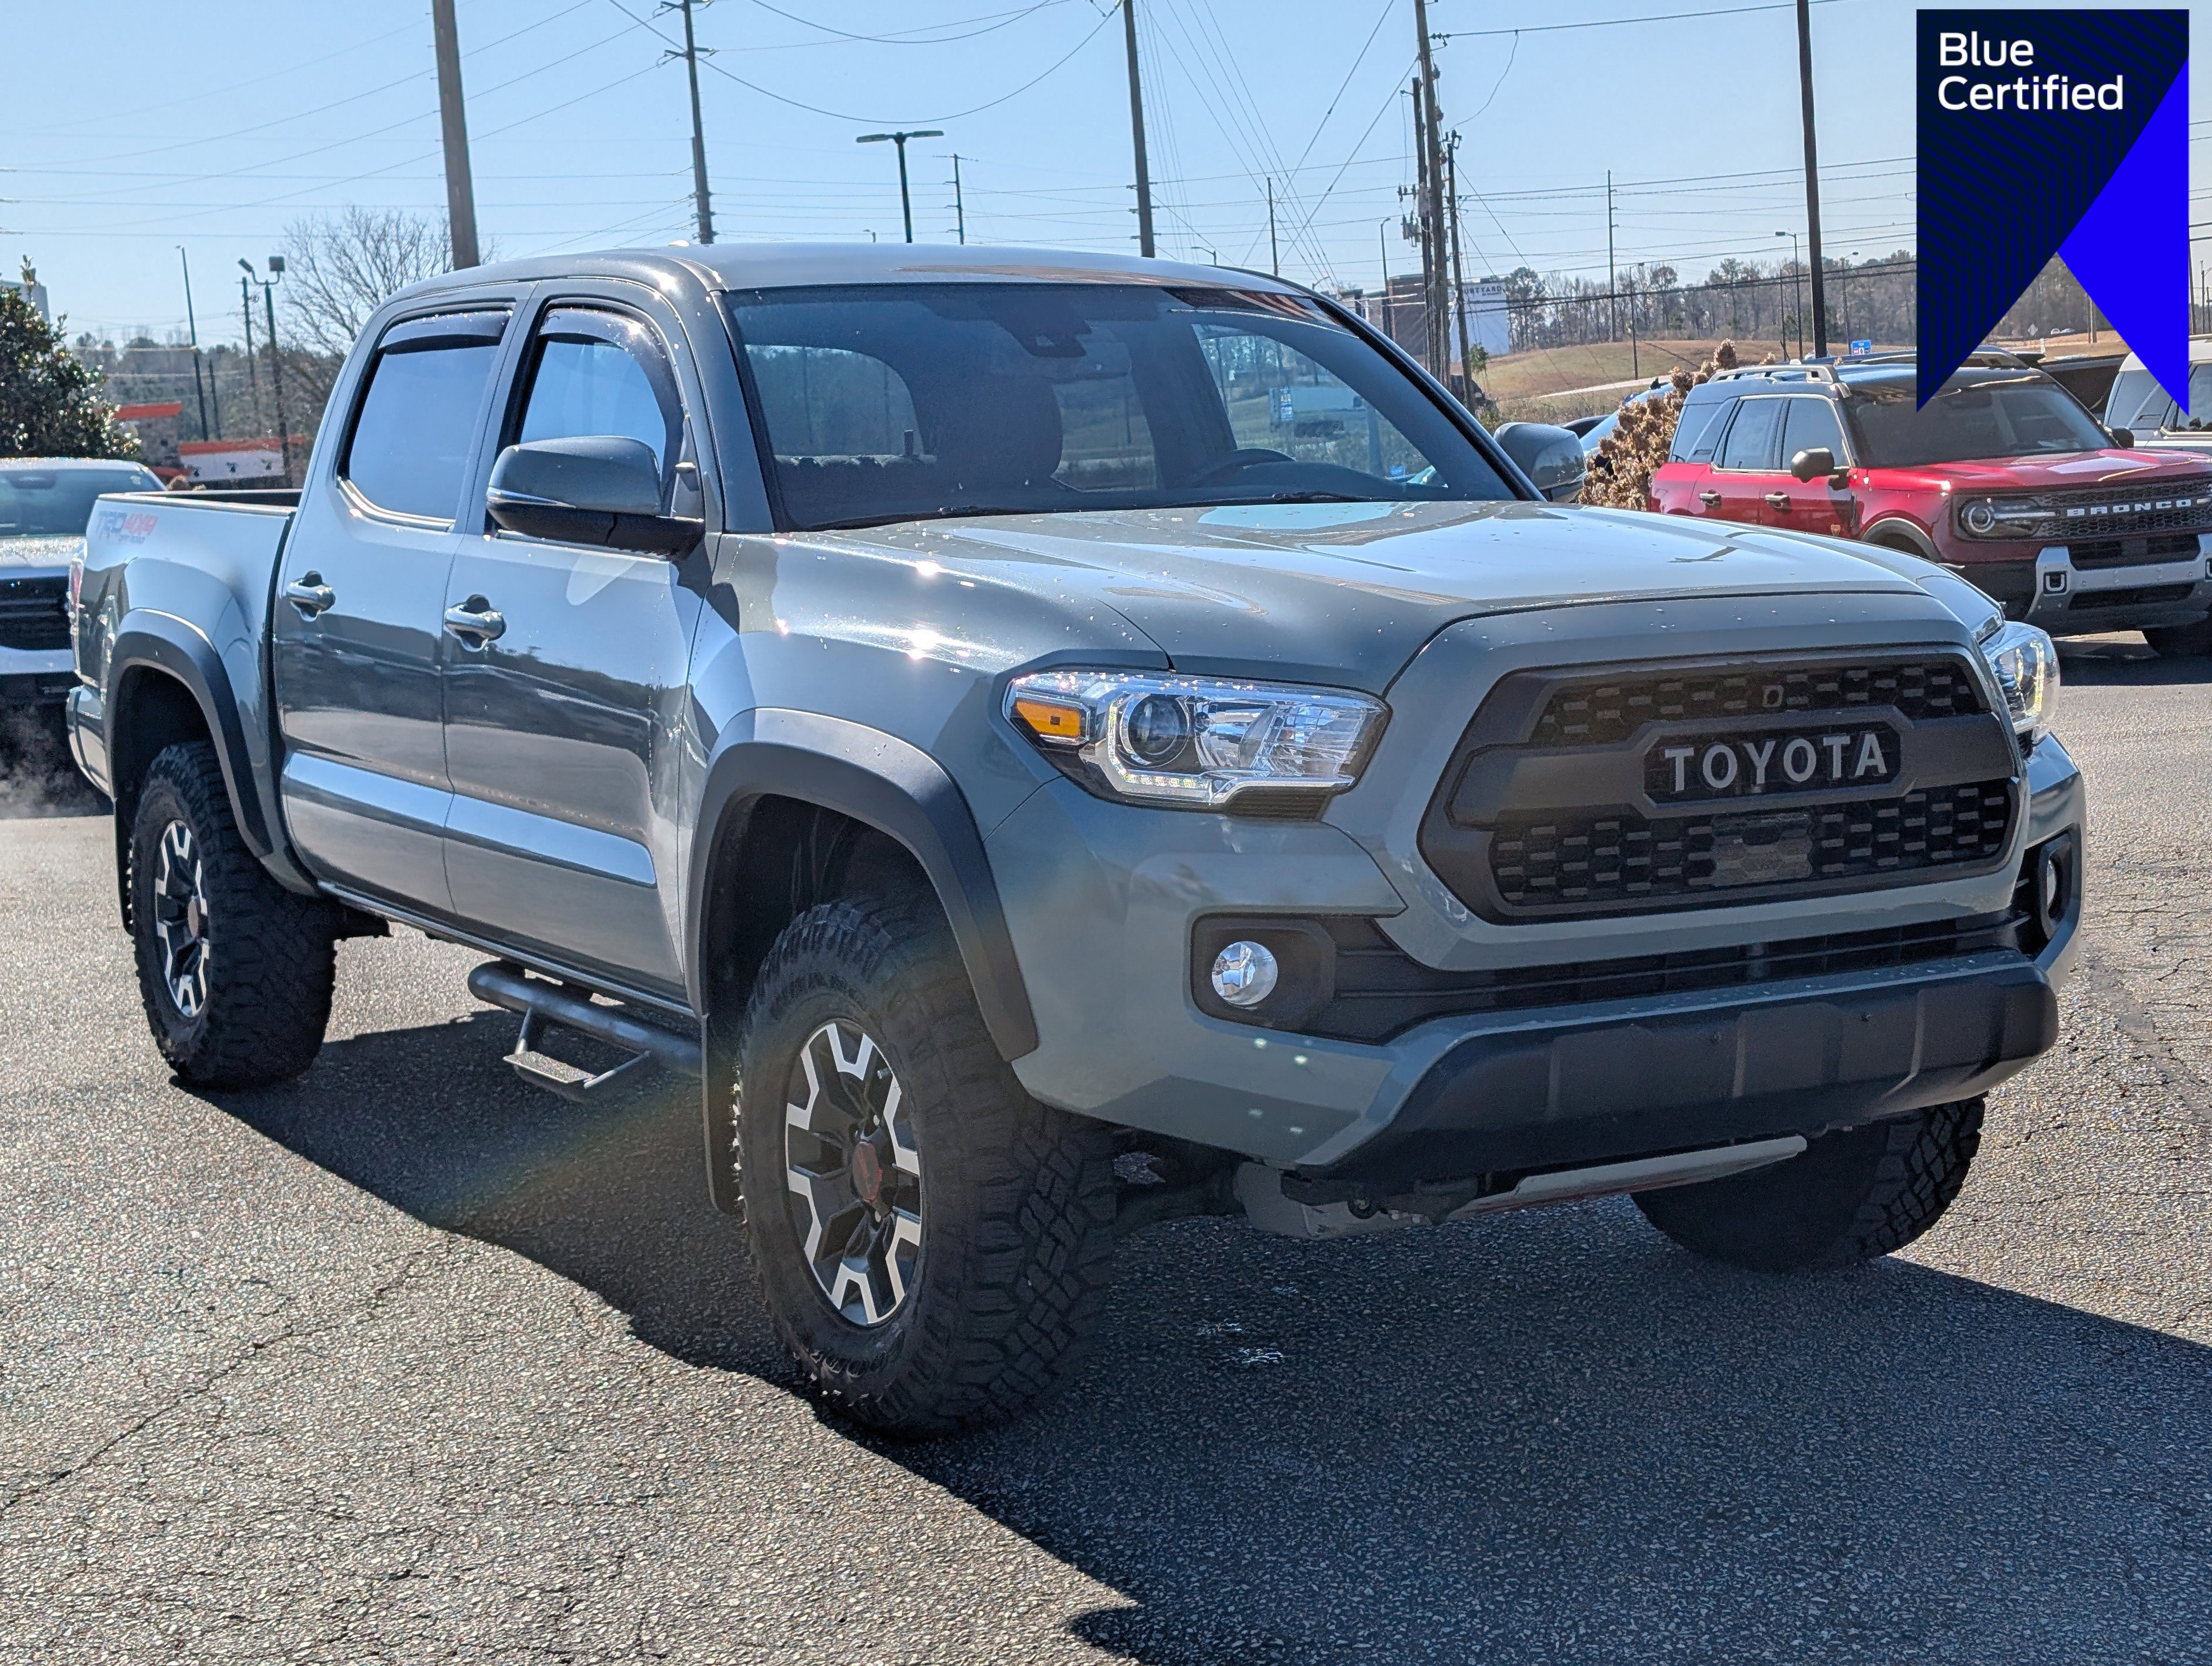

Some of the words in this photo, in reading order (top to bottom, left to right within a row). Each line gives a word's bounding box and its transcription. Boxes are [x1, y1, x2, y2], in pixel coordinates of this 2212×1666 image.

[1463, 285, 1502, 294] URTYARD
[2067, 499, 2191, 516] BRONCO
[1664, 732, 1888, 792] TOYOTA
